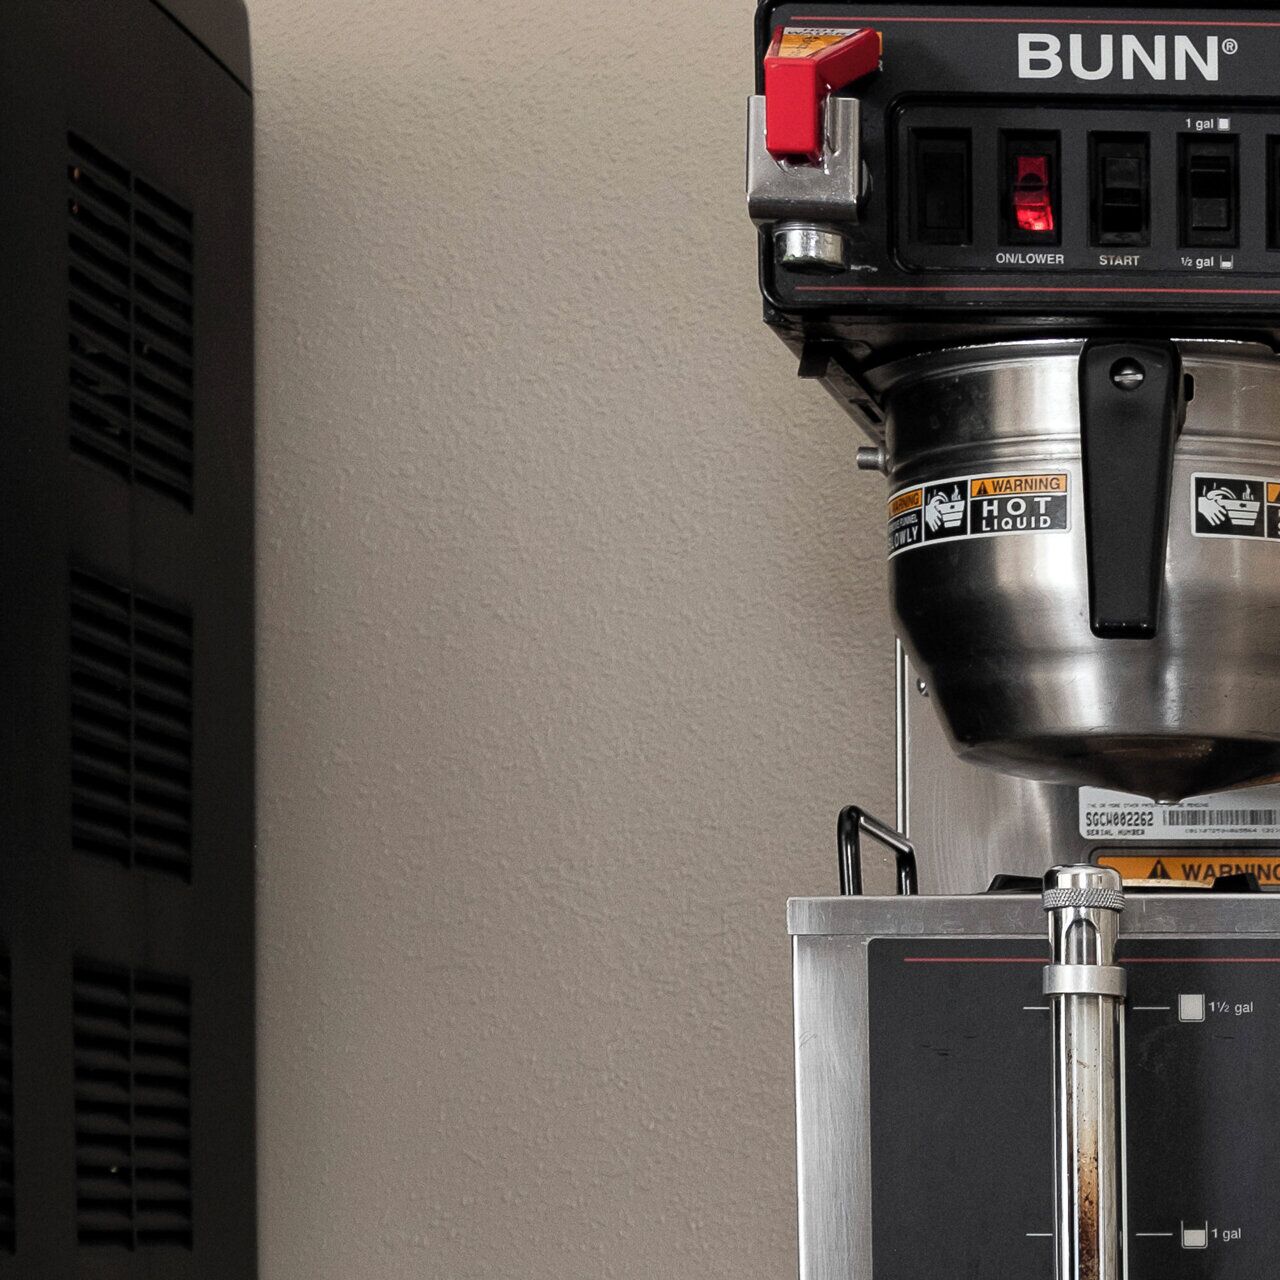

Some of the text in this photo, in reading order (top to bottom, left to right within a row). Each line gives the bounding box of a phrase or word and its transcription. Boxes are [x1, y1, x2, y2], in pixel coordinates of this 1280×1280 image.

[1185, 117, 1215, 131] 1 gal
[995, 252, 1065, 266] ON/LOWER
[1098, 254, 1140, 267] START
[1195, 254, 1214, 270] gal
[991, 477, 1061, 494] WARNING
[981, 496, 1053, 518] HOT
[981, 516, 1052, 532] LIQUID
[1085, 811, 1154, 827] SGCW002262
[1086, 828, 1146, 836] SERIAL NUMBER
[1234, 1001, 1254, 1016] gal
[1211, 1227, 1242, 1242] 1 gal
